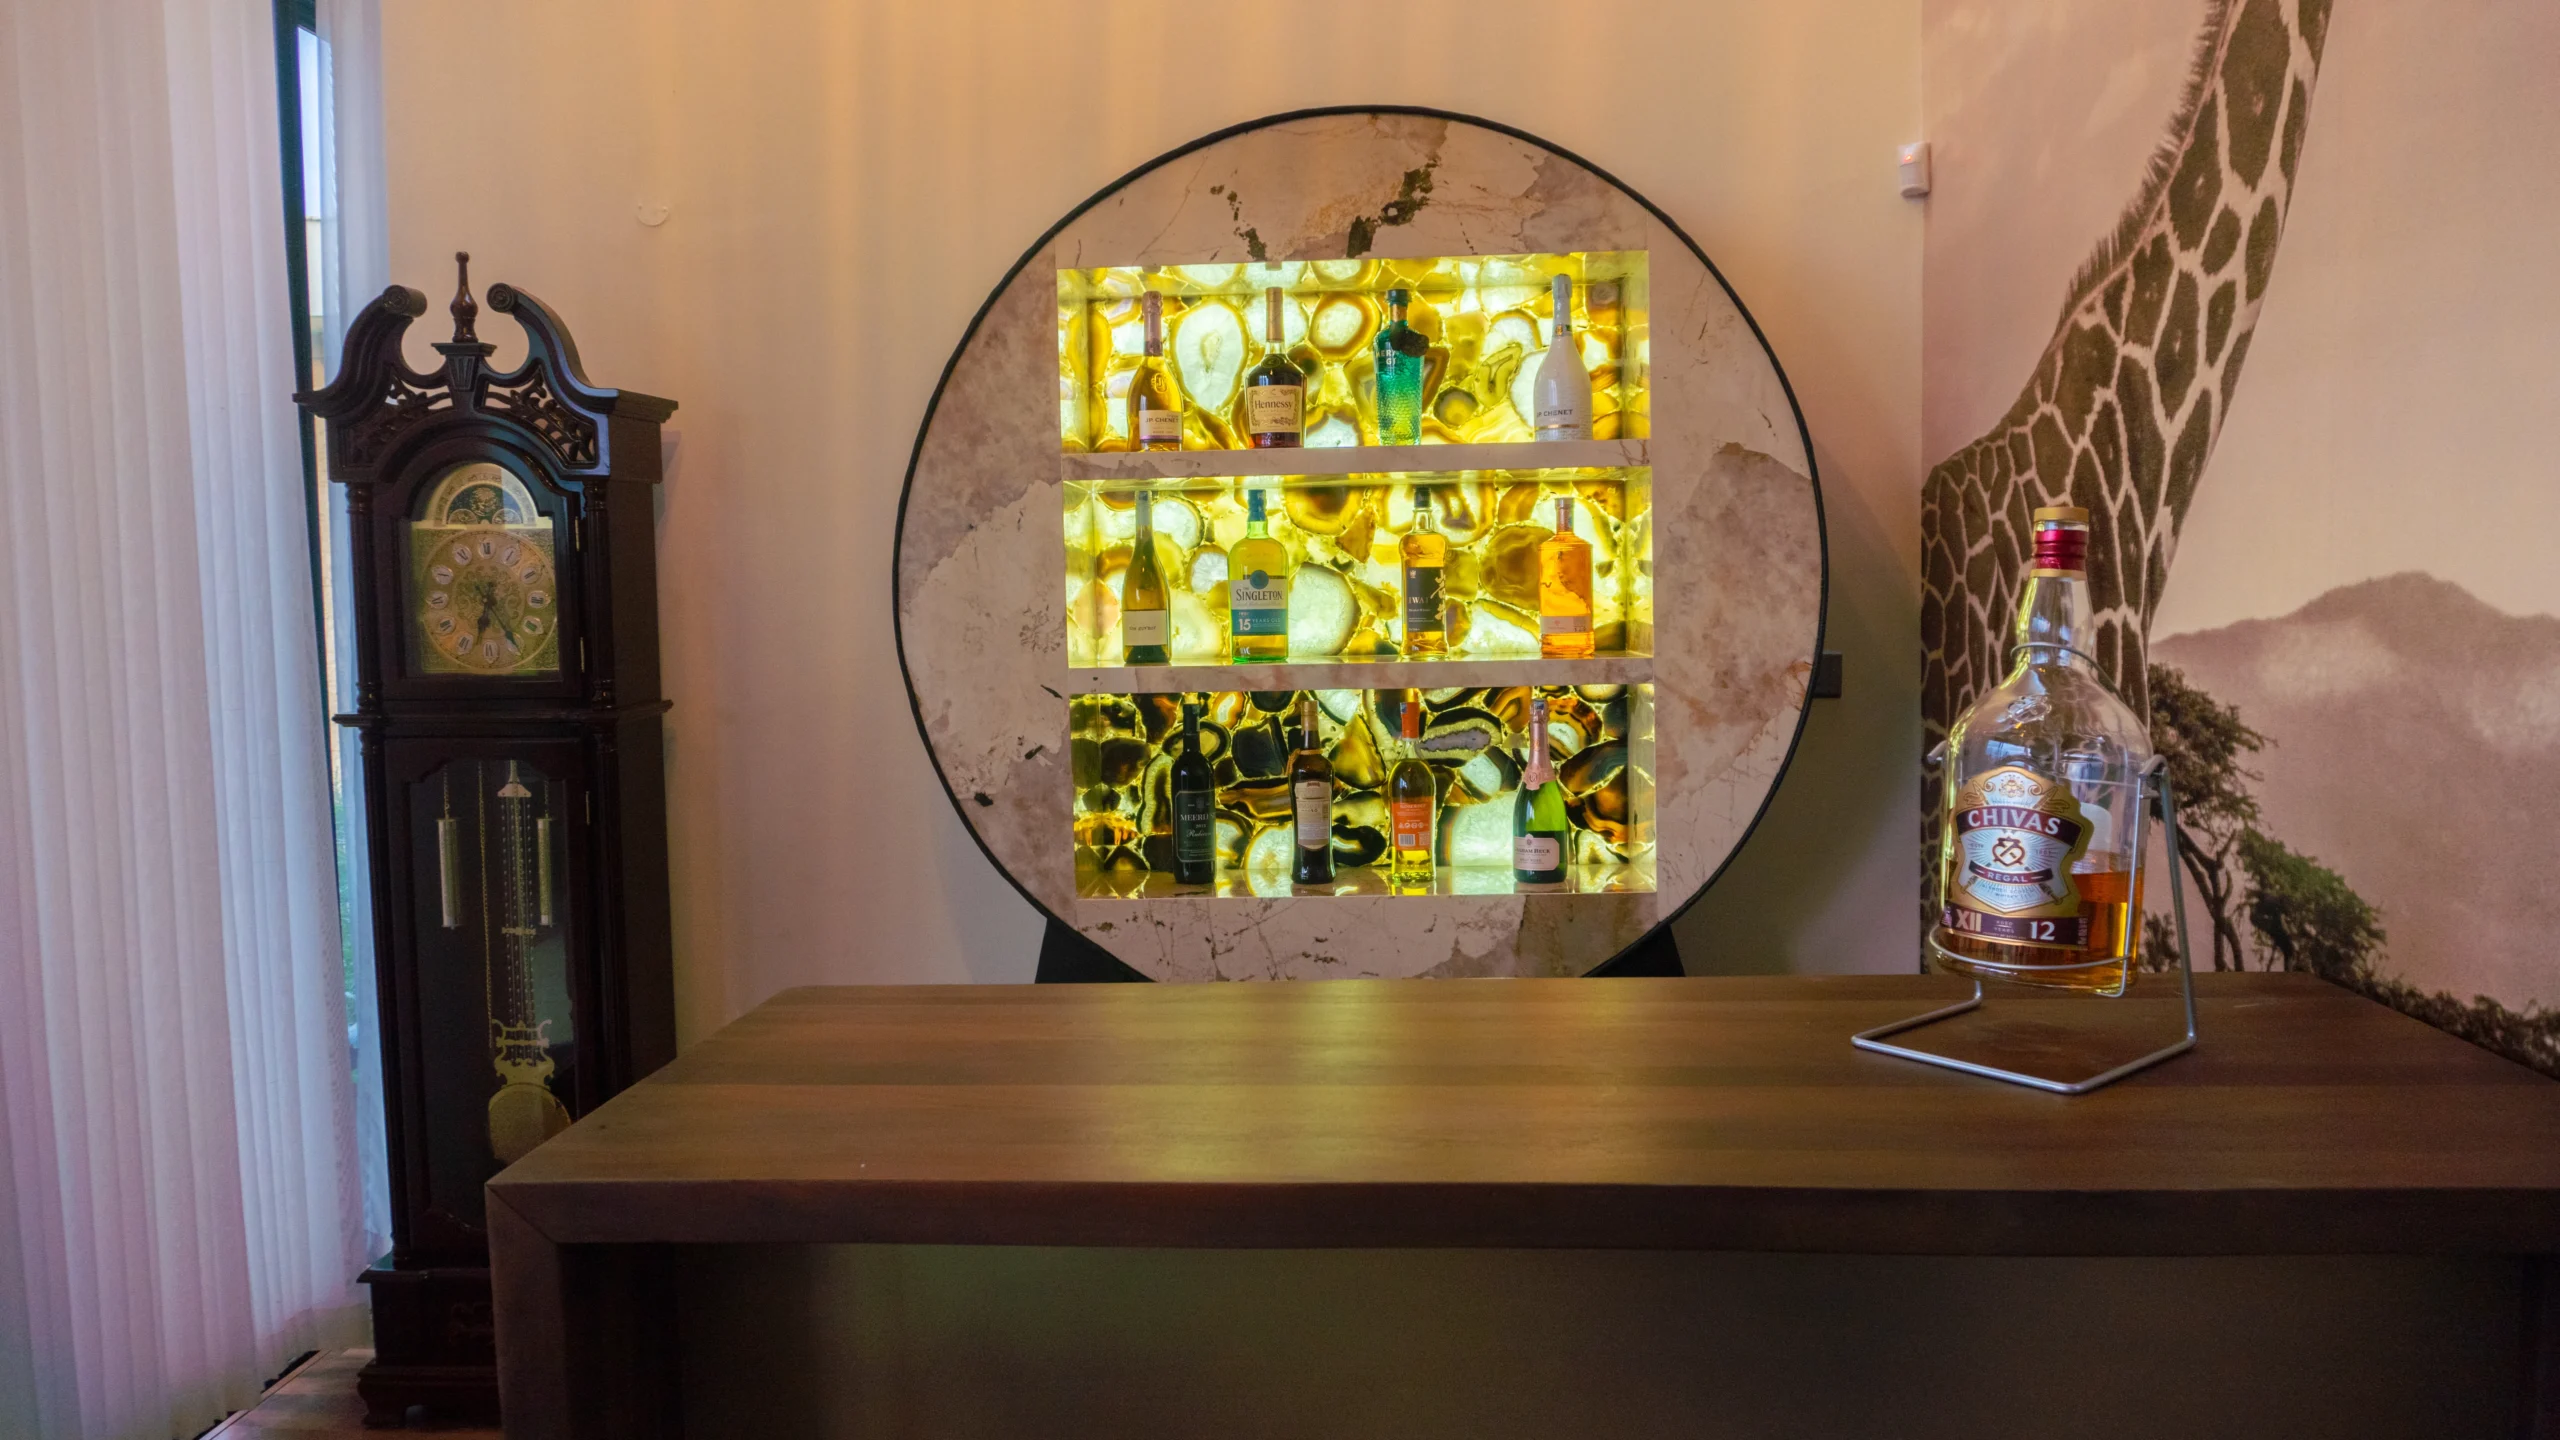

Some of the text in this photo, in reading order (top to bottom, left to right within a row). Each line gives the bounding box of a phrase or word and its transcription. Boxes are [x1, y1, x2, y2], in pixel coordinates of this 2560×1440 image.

[1254, 399, 1292, 409] Hennessy
[1235, 588, 1284, 602] SINGLETON
[1238, 617, 1252, 631] 15
[1967, 807, 2061, 835] CHIVAS
[1986, 871, 2029, 883] REGAL
[1955, 908, 1983, 932] XII
[2030, 920, 2056, 941] 12
